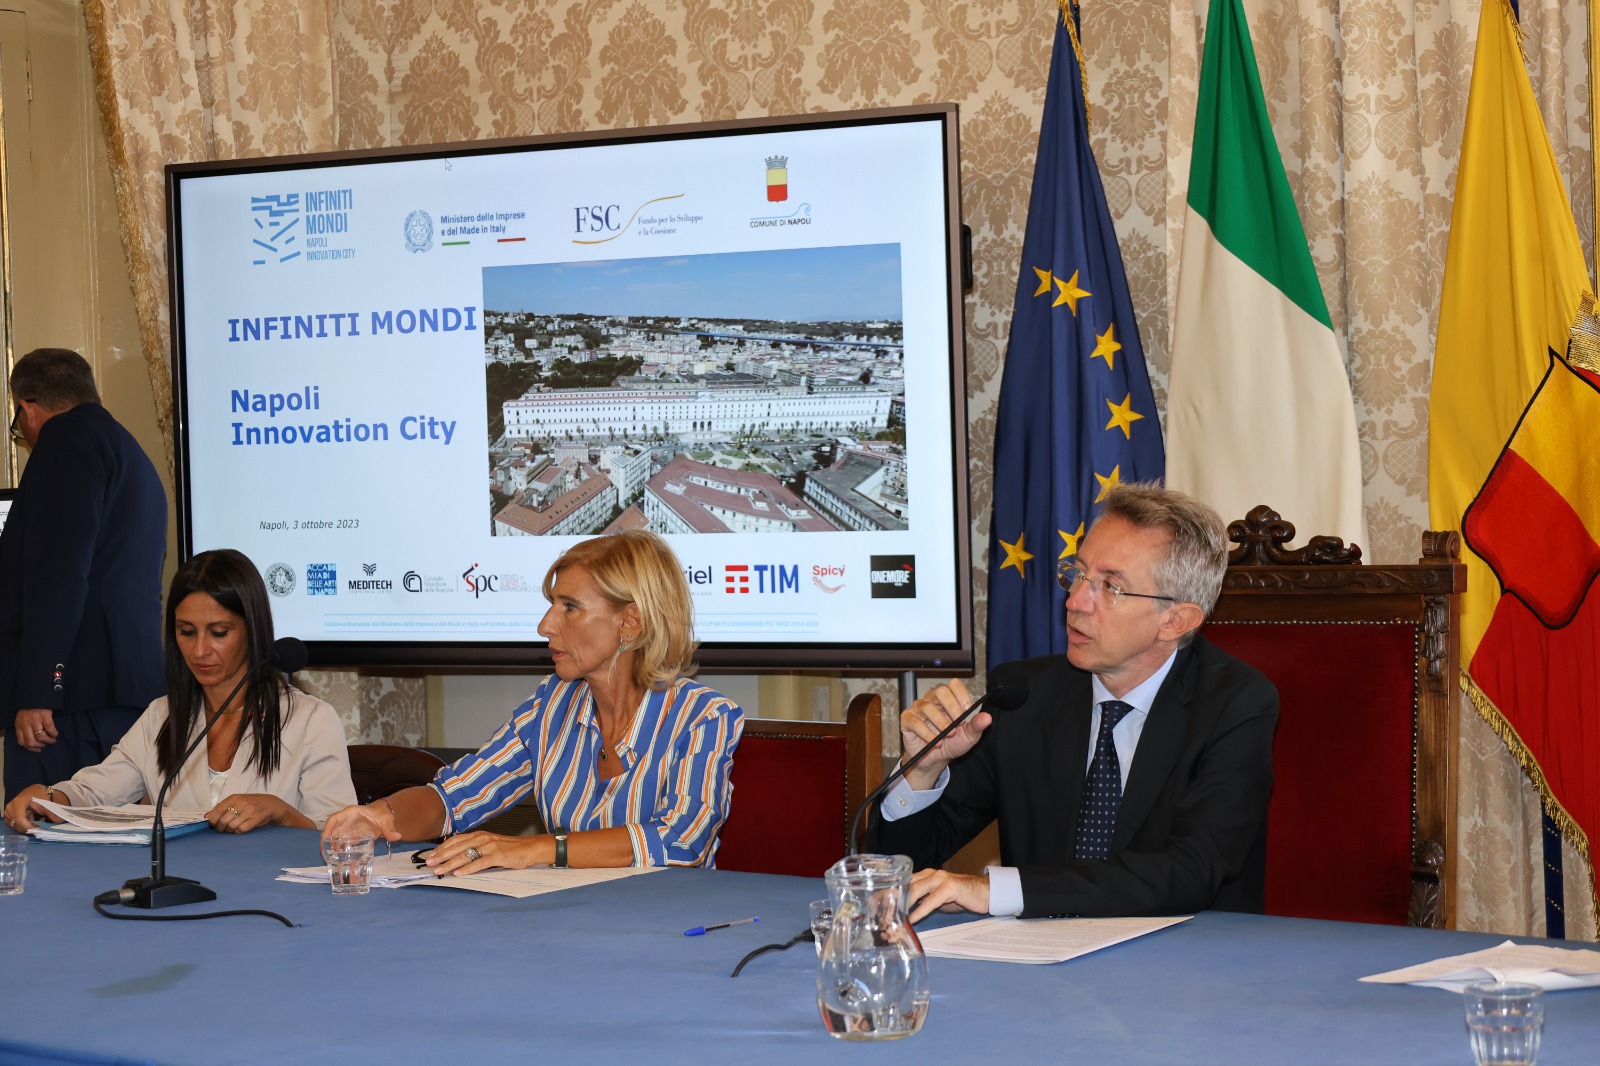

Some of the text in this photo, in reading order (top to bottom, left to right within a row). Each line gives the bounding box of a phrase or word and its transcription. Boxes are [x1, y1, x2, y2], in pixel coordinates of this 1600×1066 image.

[305, 188, 352, 212] INFINITI
[305, 212, 348, 235] MONDI
[440, 211, 526, 224] Ministero delle Imprese
[573, 204, 621, 233] FSC
[637, 213, 703, 227] Fondo per lo Sviluppo
[749, 217, 811, 228] COMUNE DI NAPOLI
[447, 227, 458, 236] del
[459, 226, 480, 235] Made
[481, 225, 488, 233] in
[490, 224, 506, 234] Italy
[643, 227, 649, 236] la
[649, 226, 677, 236] Coesione
[306, 237, 328, 248] NAPOLI
[306, 248, 355, 261] INNOVATION CITY
[228, 306, 477, 342] INFINITI MONDI
[230, 385, 320, 417] Napoli
[231, 415, 457, 446] Innovation City
[259, 519, 360, 532] Napoli, 3 ottobre 2023
[685, 565, 713, 585] iel
[812, 565, 845, 577] Spicy
[871, 570, 910, 584] ONEMORE
[348, 580, 392, 590] MEDITECH
[754, 564, 799, 594] TIM
